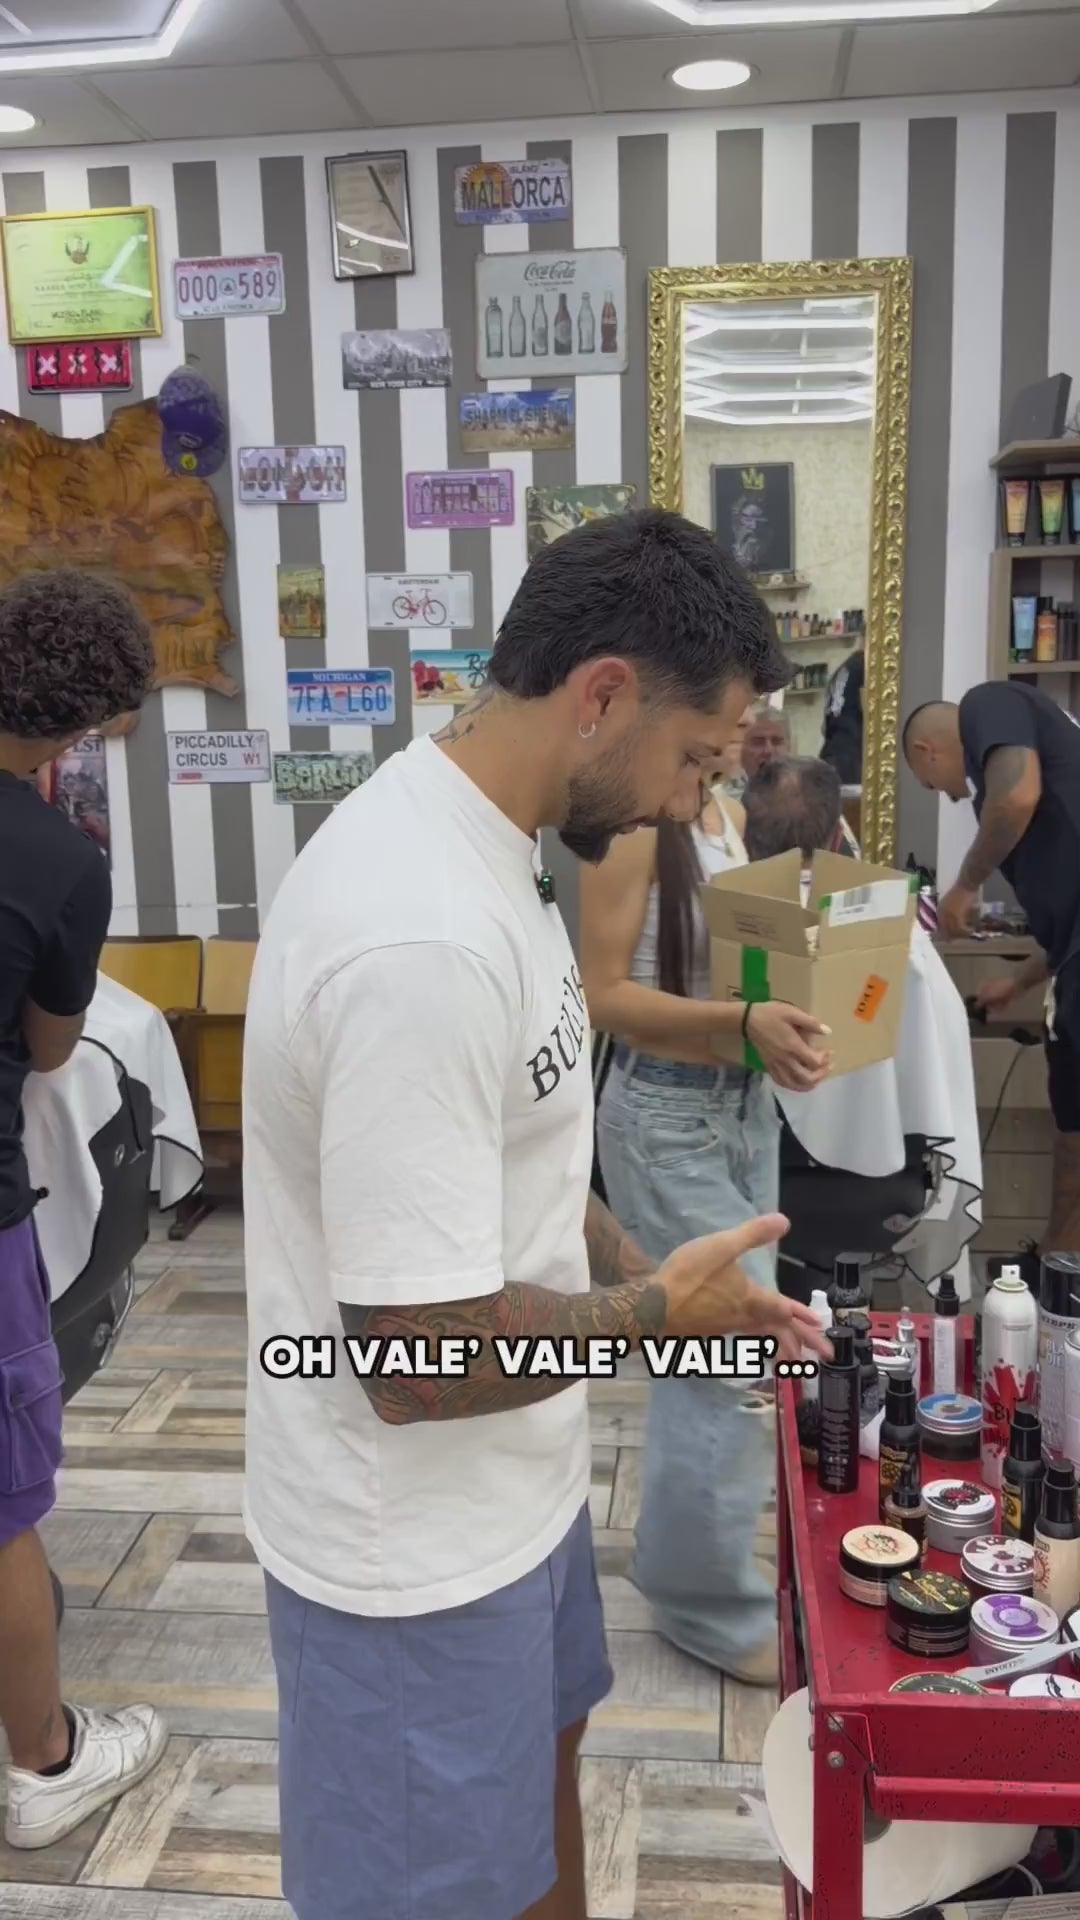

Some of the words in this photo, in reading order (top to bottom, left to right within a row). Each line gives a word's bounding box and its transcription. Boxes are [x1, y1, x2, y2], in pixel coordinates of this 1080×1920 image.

[462, 175, 566, 211] MALLORCA
[179, 274, 217, 303] 000
[238, 270, 276, 299] 589
[313, 672, 366, 682] MICHIGAN
[292, 685, 332, 713] 7FA
[347, 685, 387, 713] L60
[175, 734, 254, 749] PICCADILLY
[176, 753, 228, 766] CIRCUS
[243, 752, 261, 765] W1
